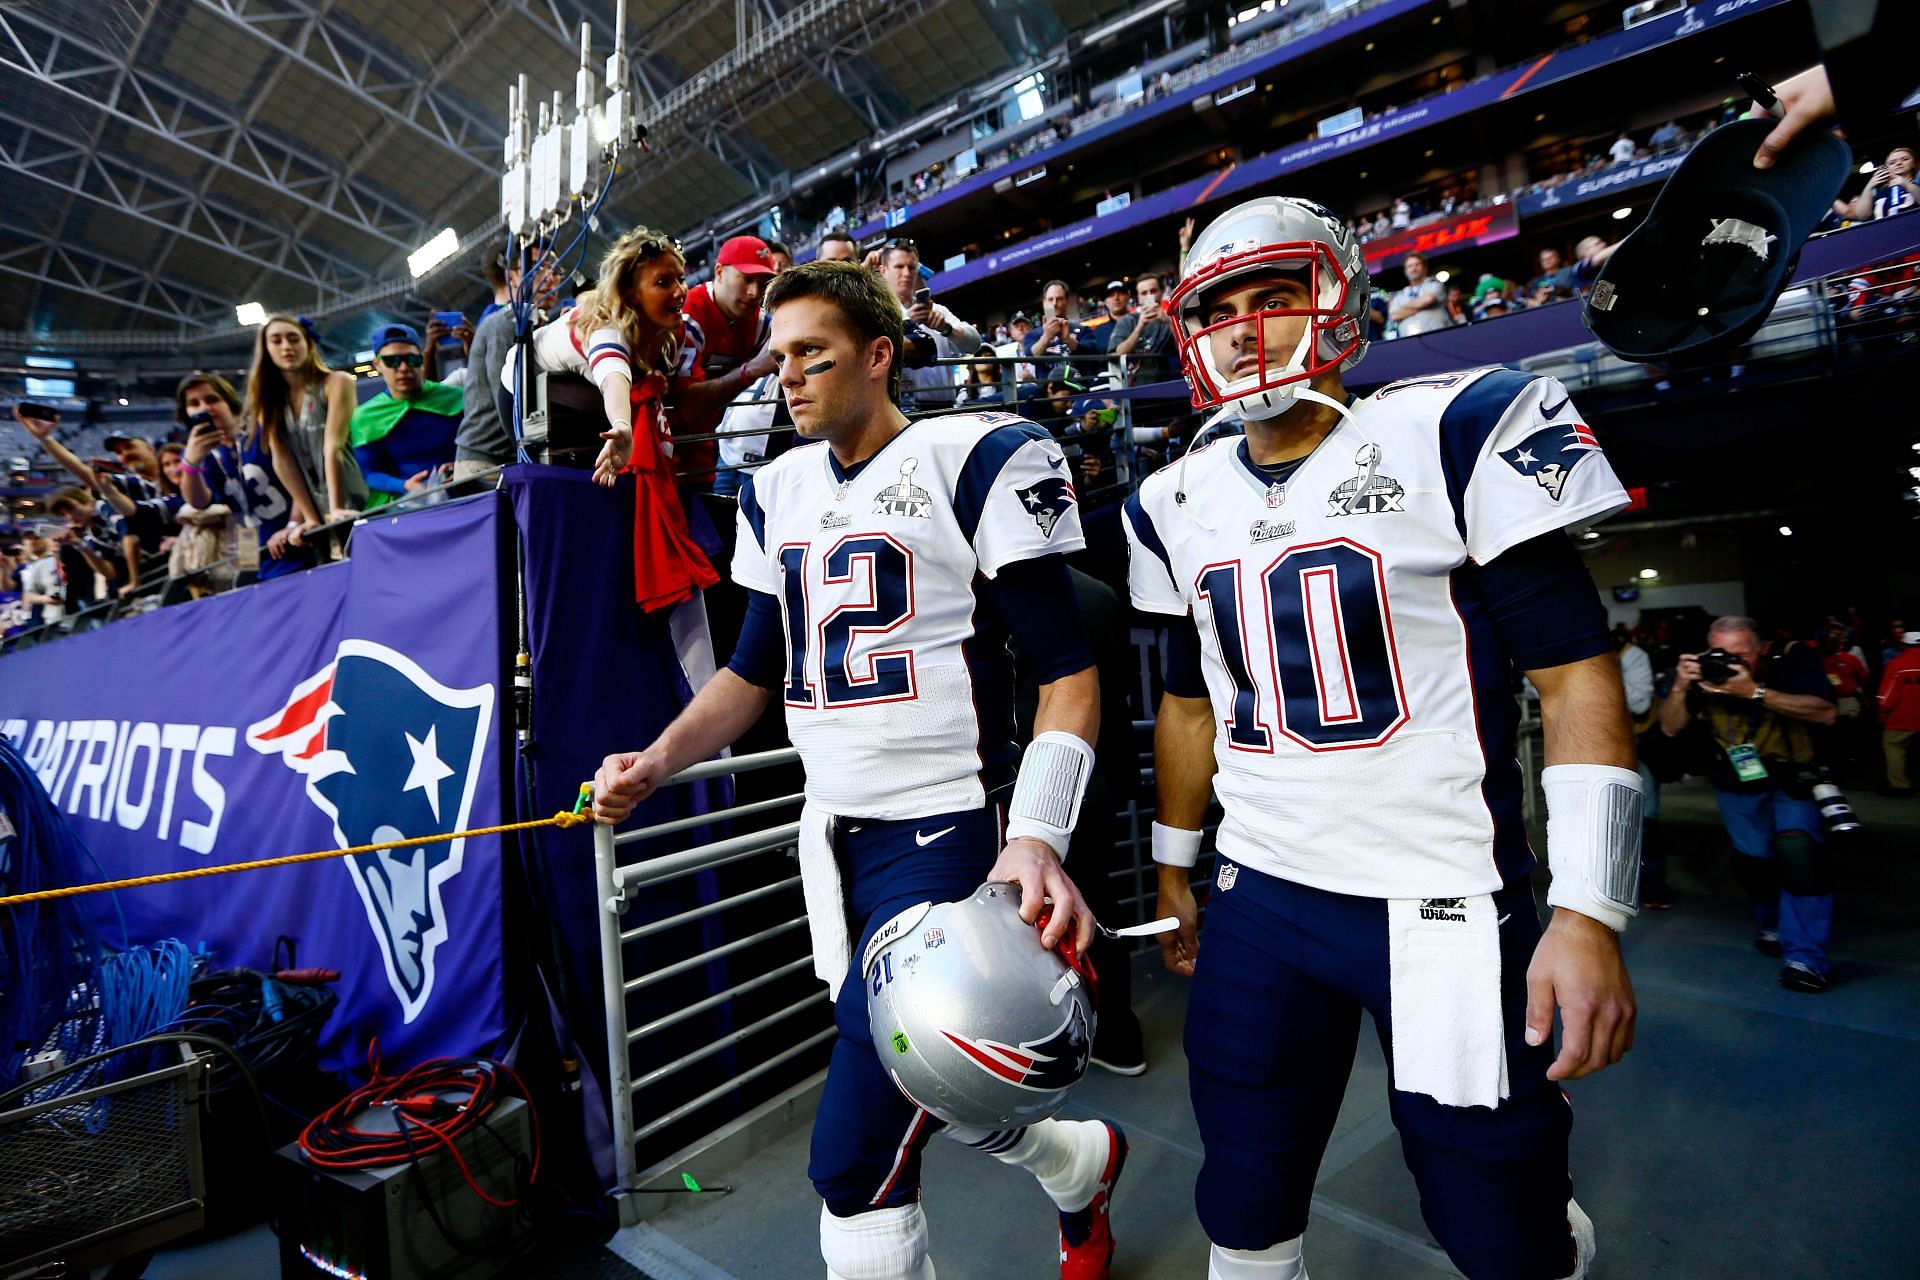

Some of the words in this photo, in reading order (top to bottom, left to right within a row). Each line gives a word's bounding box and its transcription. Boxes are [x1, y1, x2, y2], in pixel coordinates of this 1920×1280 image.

[1576, 167, 1640, 195] SUPER
[891, 207, 906, 228] 12
[872, 500, 932, 519] XLIX
[1267, 494, 1284, 507] NFL
[1250, 520, 1298, 544] Patriots
[777, 532, 918, 709] 12
[1195, 537, 1411, 754] 10
[24, 719, 237, 855] PATRIOTS
[1419, 908, 1467, 923] Wilson
[872, 951, 894, 997] 12
